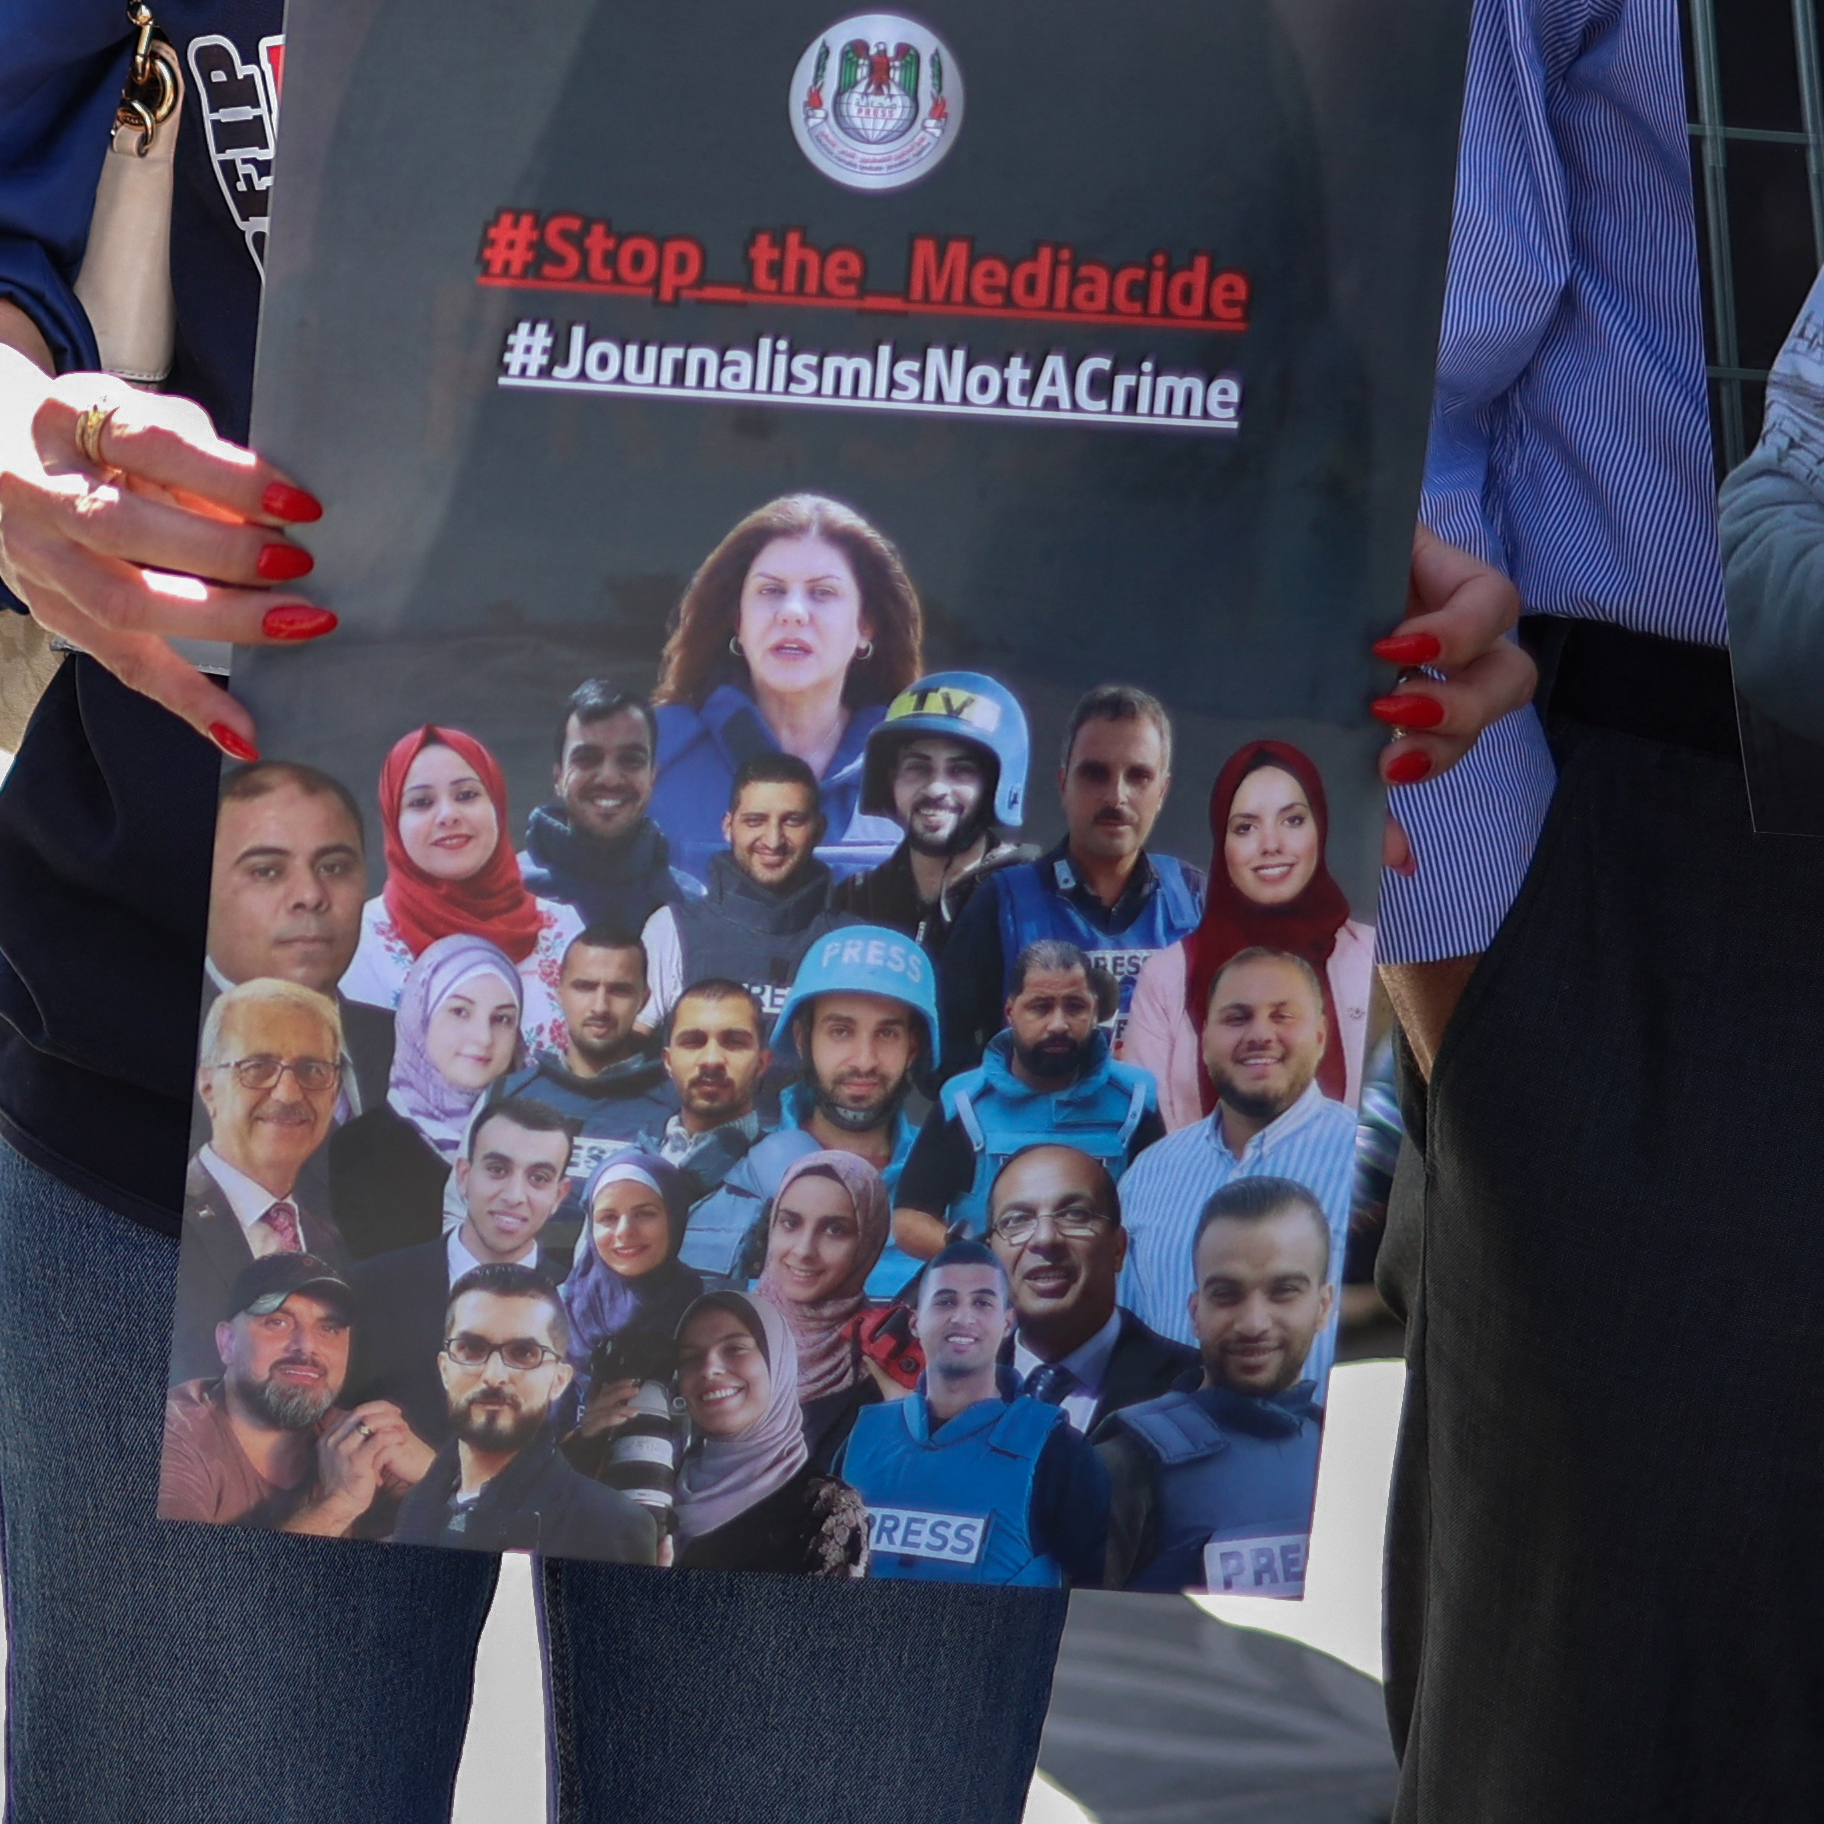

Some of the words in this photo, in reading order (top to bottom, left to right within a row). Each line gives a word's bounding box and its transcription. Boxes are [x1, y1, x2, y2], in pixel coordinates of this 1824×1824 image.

[856, 108, 896, 118] PRESS
[498, 319, 1241, 429] #JournalismIsNotACrime
[909, 686, 976, 717] TV
[820, 938, 923, 984] PRESS
